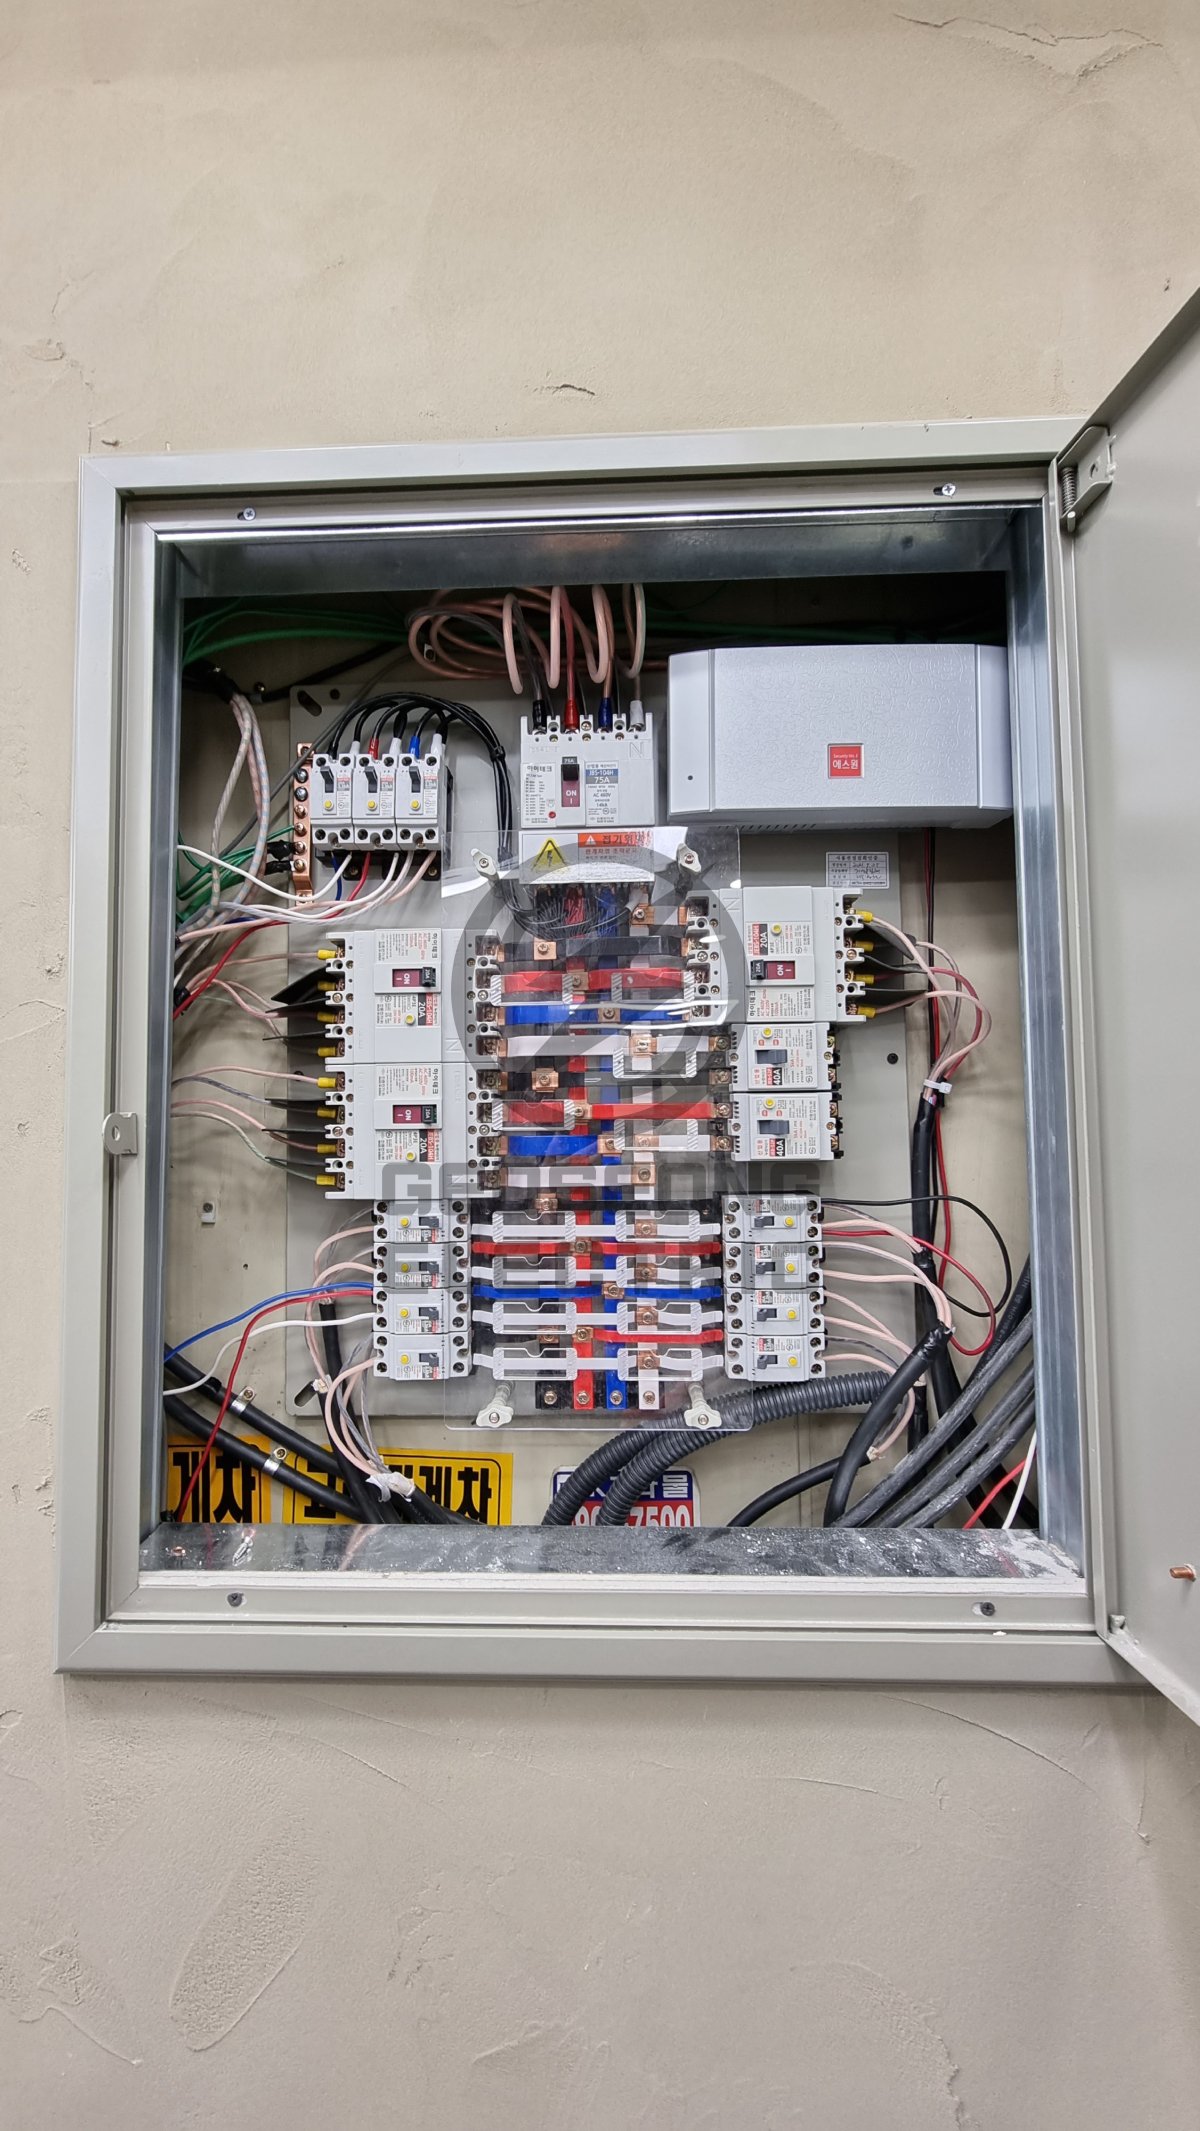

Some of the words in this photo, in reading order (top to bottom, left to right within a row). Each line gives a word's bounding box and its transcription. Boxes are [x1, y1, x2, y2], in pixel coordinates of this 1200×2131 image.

[832, 759, 859, 770] 에스원
[594, 776, 610, 784] 75A
[777, 965, 784, 976] ON
[404, 973, 410, 984] ON
[405, 1109, 412, 1121] ON
